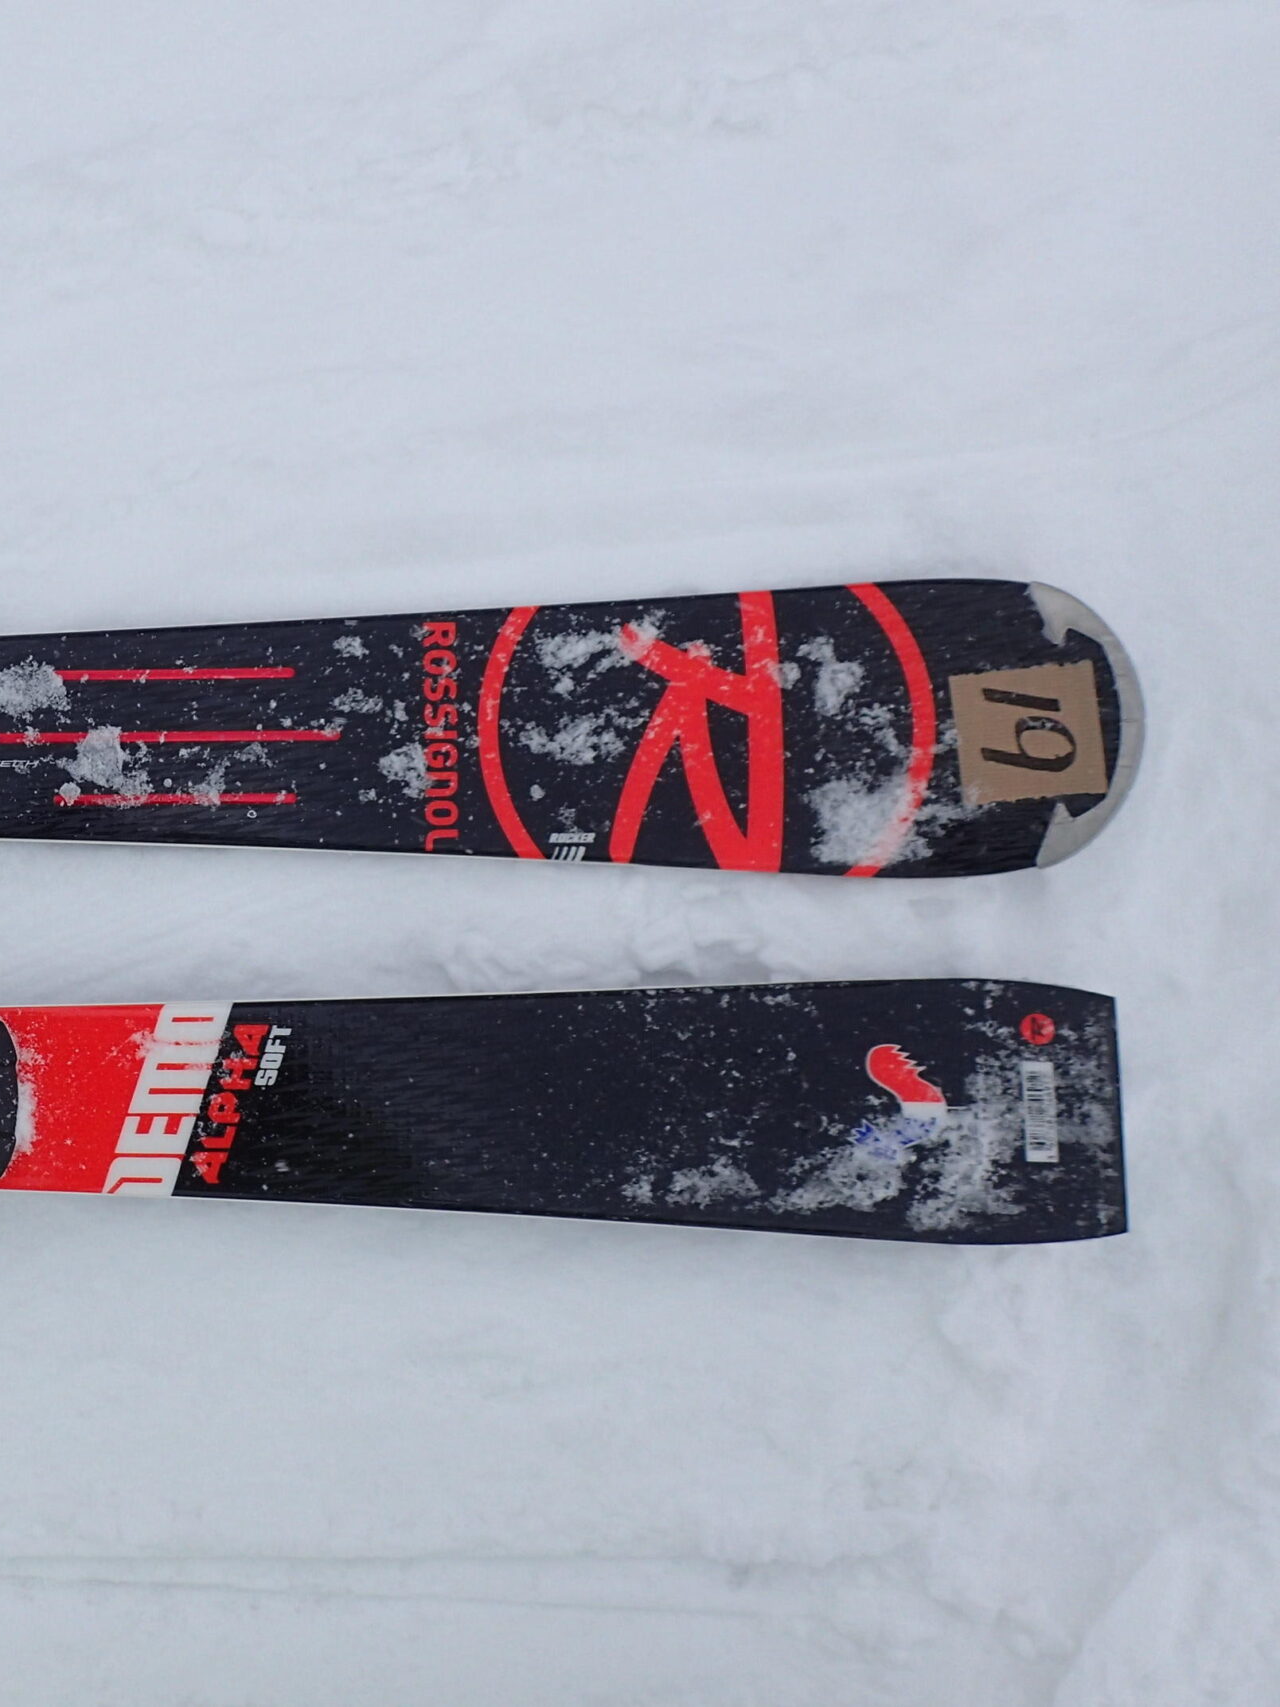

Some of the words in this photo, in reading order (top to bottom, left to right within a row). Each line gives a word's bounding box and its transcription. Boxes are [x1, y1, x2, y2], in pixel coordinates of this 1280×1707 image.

[422, 621, 459, 852] ROSSIGNOL
[548, 832, 596, 844] ROCKER
[102, 1001, 234, 1197] DEMO
[190, 1024, 270, 1184] ALPHA
[253, 1025, 292, 1086] SOFT
